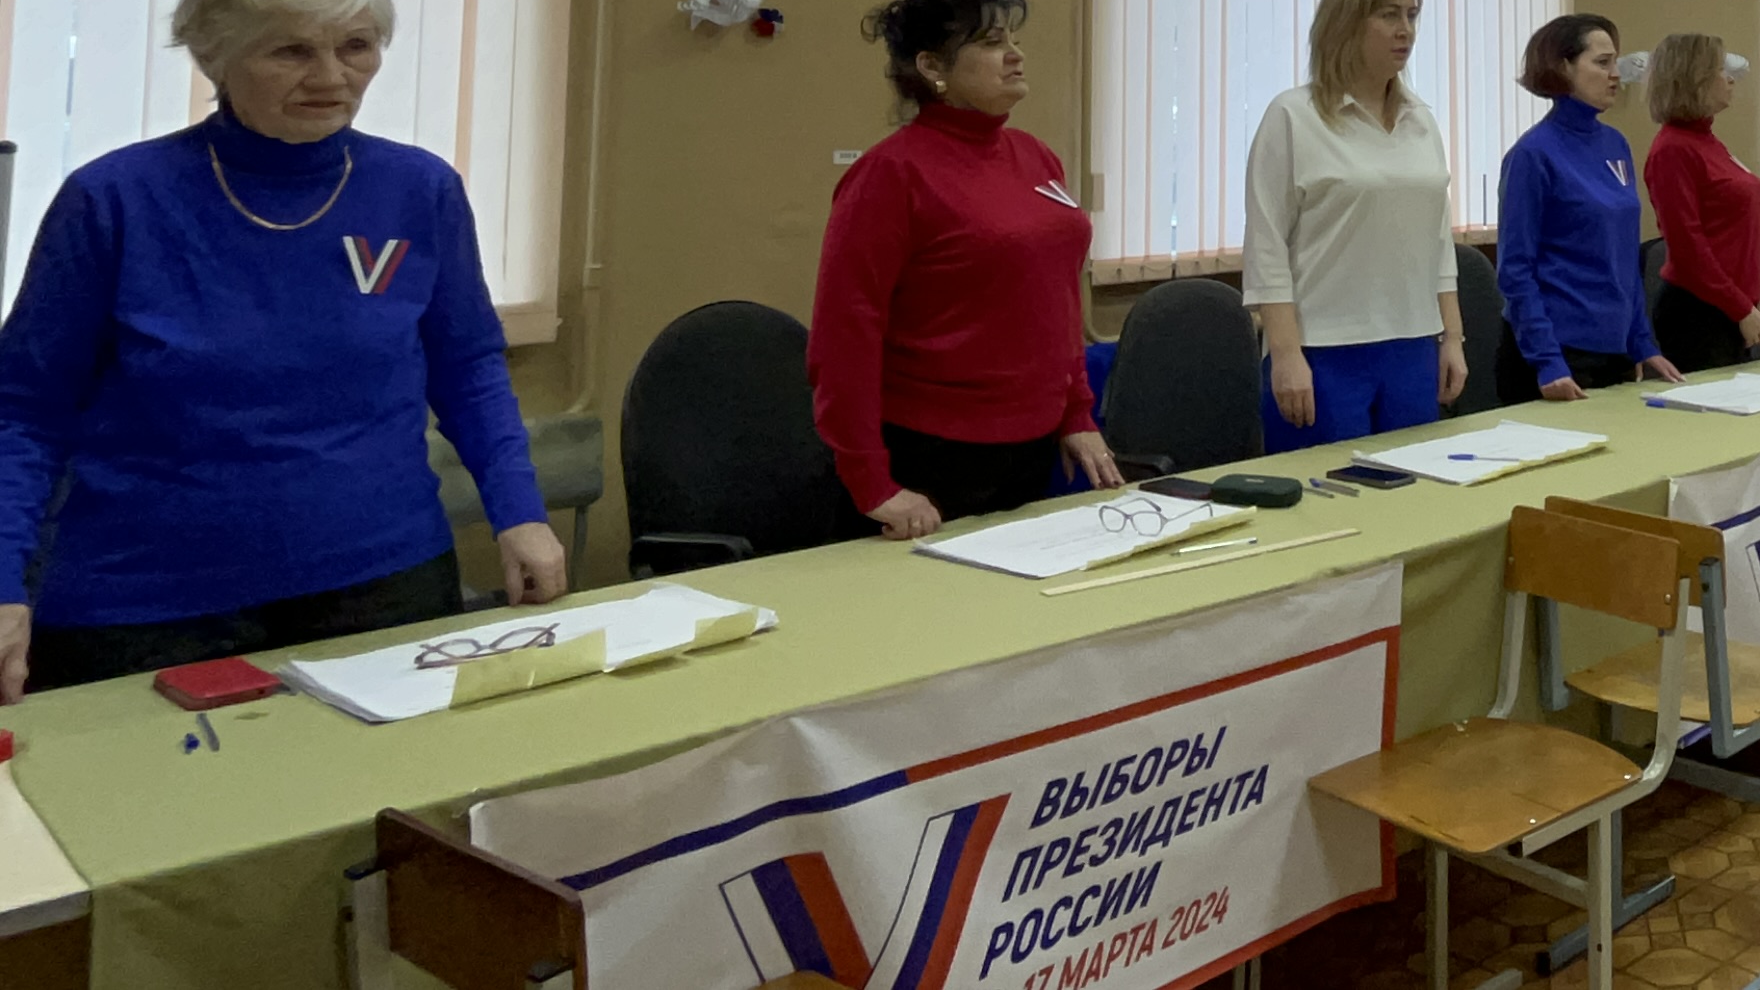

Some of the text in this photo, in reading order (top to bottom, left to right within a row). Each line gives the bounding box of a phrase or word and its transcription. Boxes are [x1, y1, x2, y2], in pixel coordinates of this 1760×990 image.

[1001, 764, 1269, 904] ПРЕЗИДЕНТА
[1028, 725, 1228, 830] ВЫБОРЫ
[979, 860, 1163, 981] РОССИИ
[1057, 917, 1158, 990] МАРТА
[1161, 885, 1229, 951] 2024
